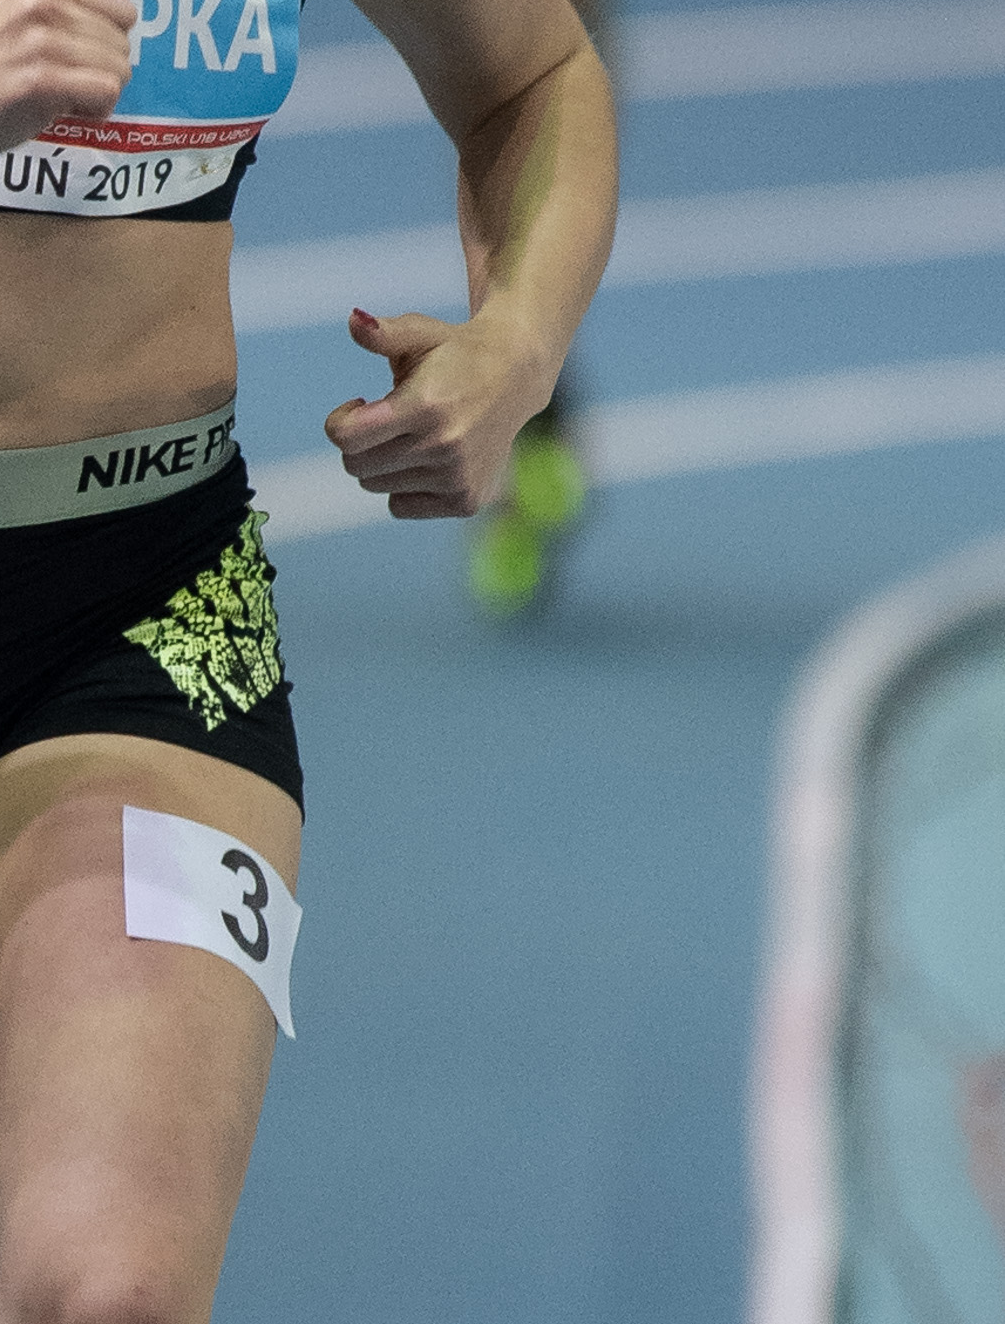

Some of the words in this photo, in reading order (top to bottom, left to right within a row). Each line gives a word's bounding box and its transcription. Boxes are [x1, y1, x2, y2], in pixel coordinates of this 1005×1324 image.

[126, 130, 187, 146] POLSKI
[82, 157, 174, 202] 2019
[76, 433, 199, 494] NIKE
[220, 847, 270, 964] 3
